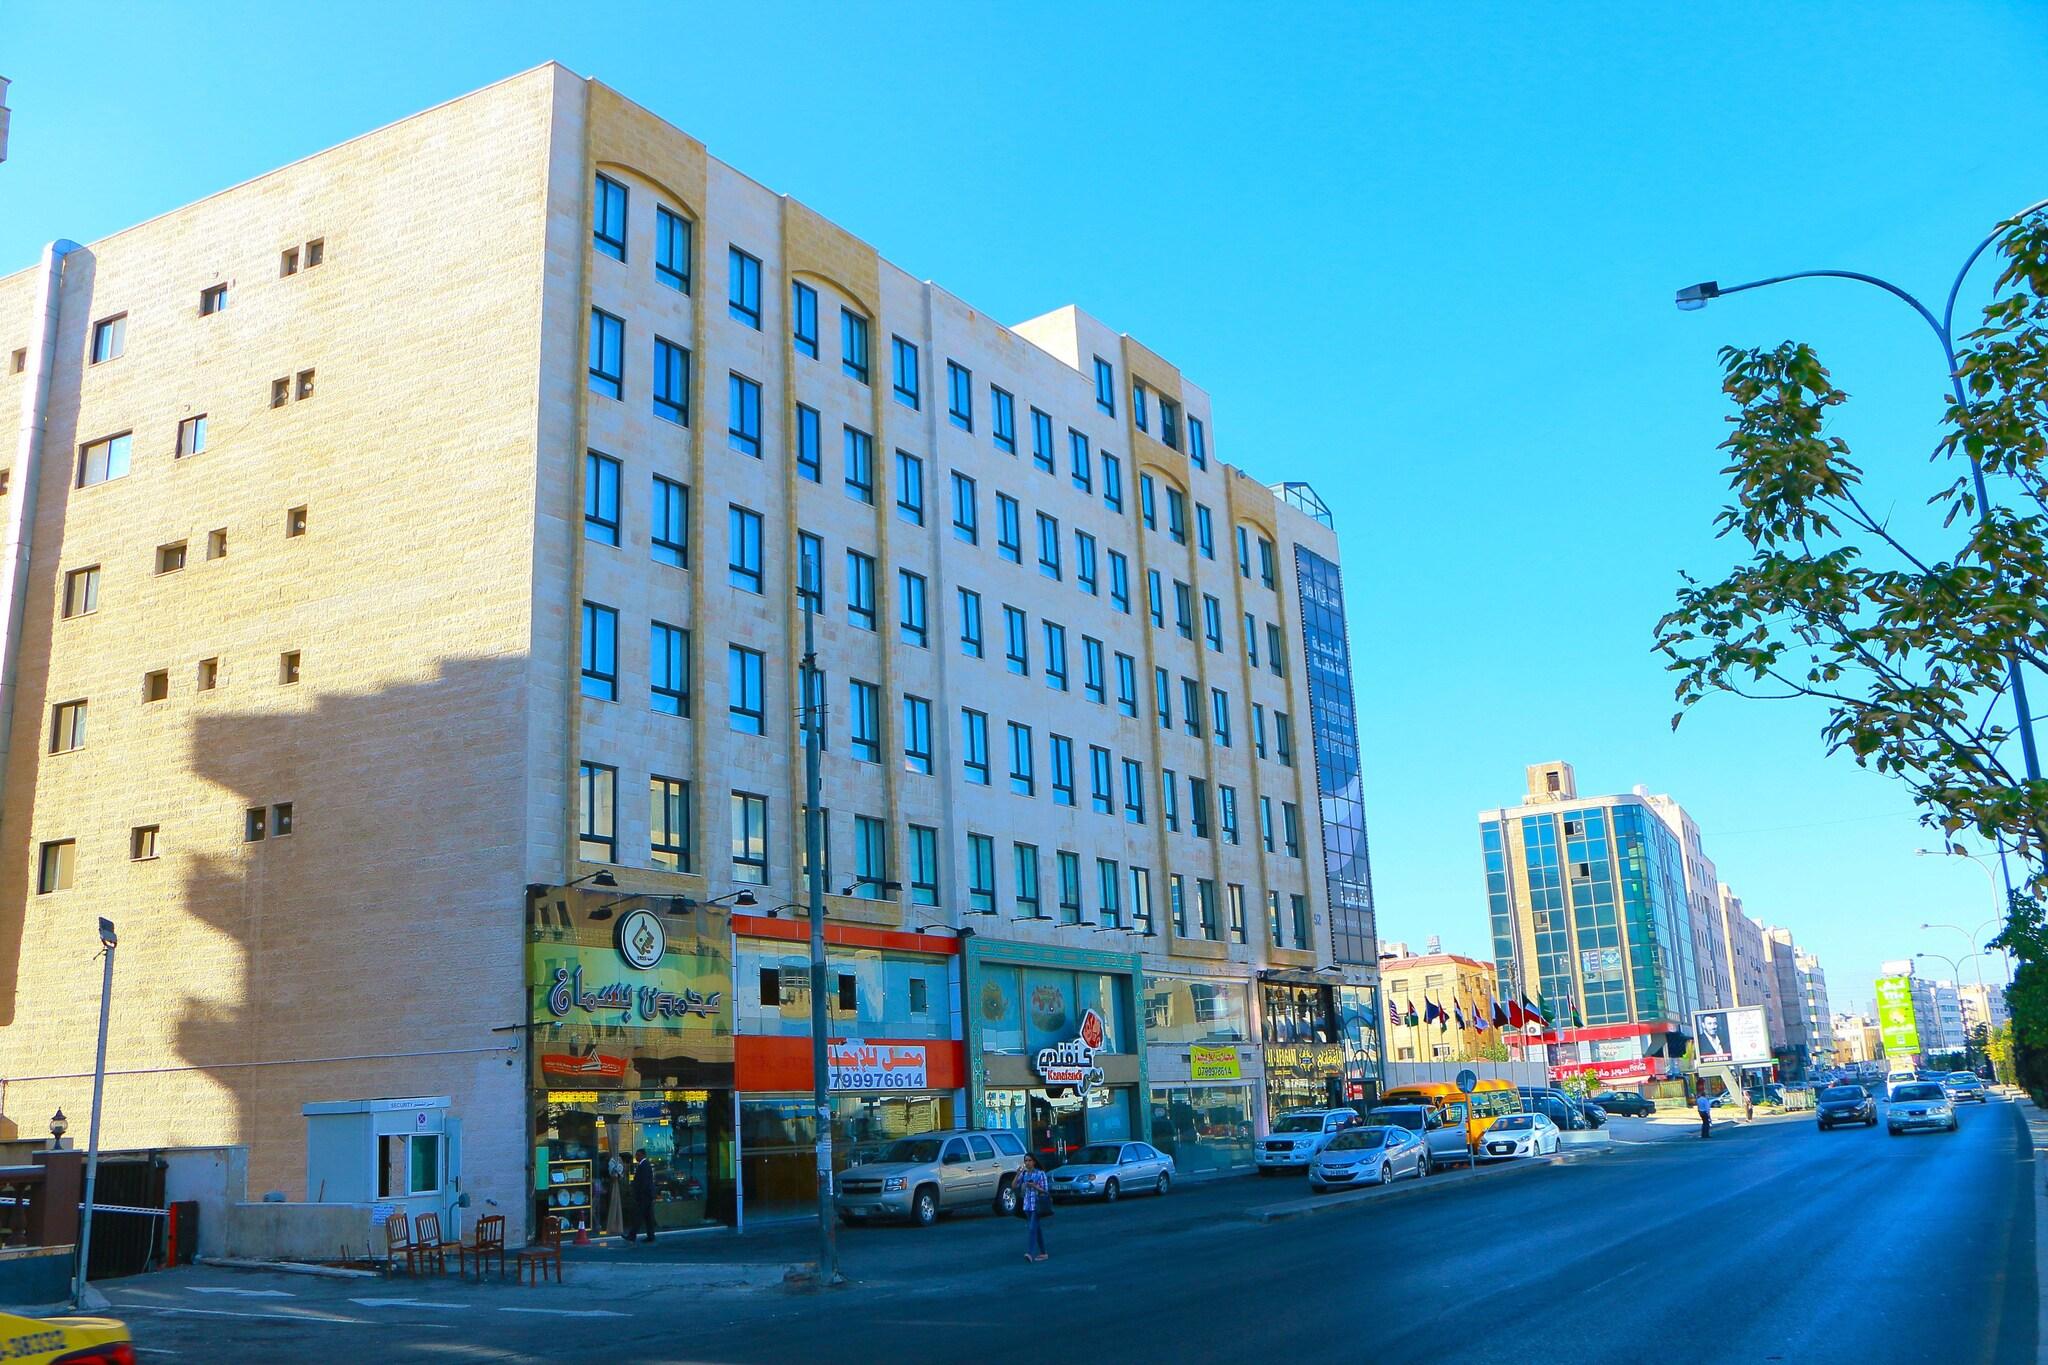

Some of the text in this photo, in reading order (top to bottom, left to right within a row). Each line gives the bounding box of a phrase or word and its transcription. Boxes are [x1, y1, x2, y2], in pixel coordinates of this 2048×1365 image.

[828, 1046, 924, 1072] محل للإيجا
[828, 1073, 924, 1089] 799976614
